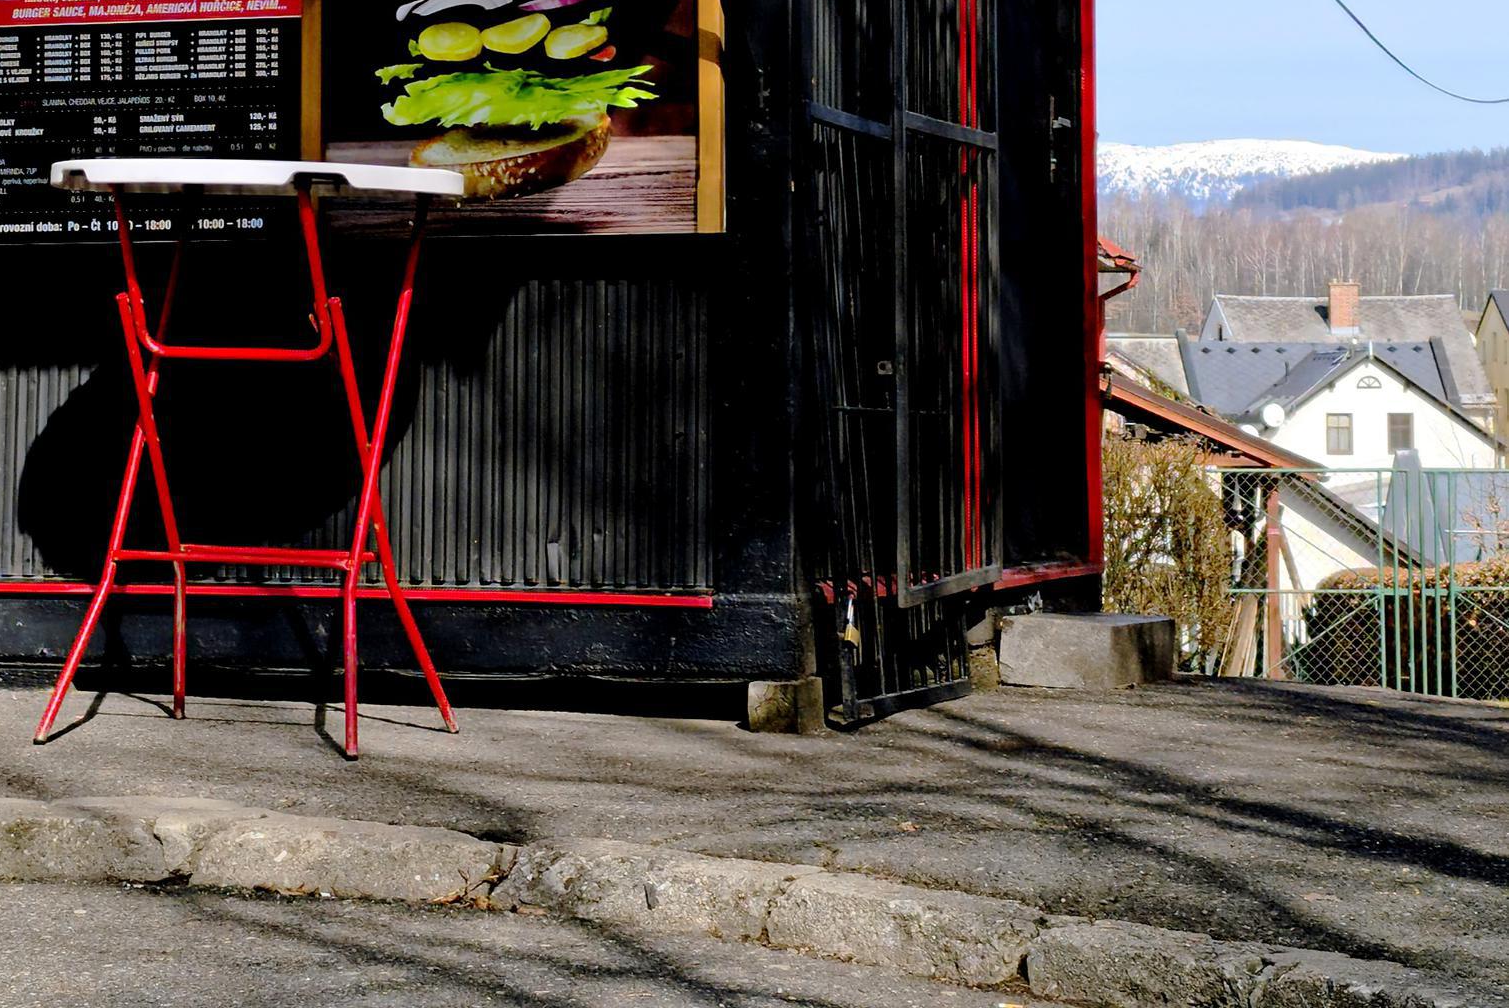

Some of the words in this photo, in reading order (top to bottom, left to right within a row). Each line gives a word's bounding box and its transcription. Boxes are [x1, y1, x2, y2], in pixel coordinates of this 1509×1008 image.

[36, 222, 62, 232] doba:
[68, 221, 79, 231] Po
[91, 219, 100, 231] Čt
[145, 220, 171, 230] 18:00
[198, 219, 224, 229] 10:00
[237, 218, 263, 228] 18:00
